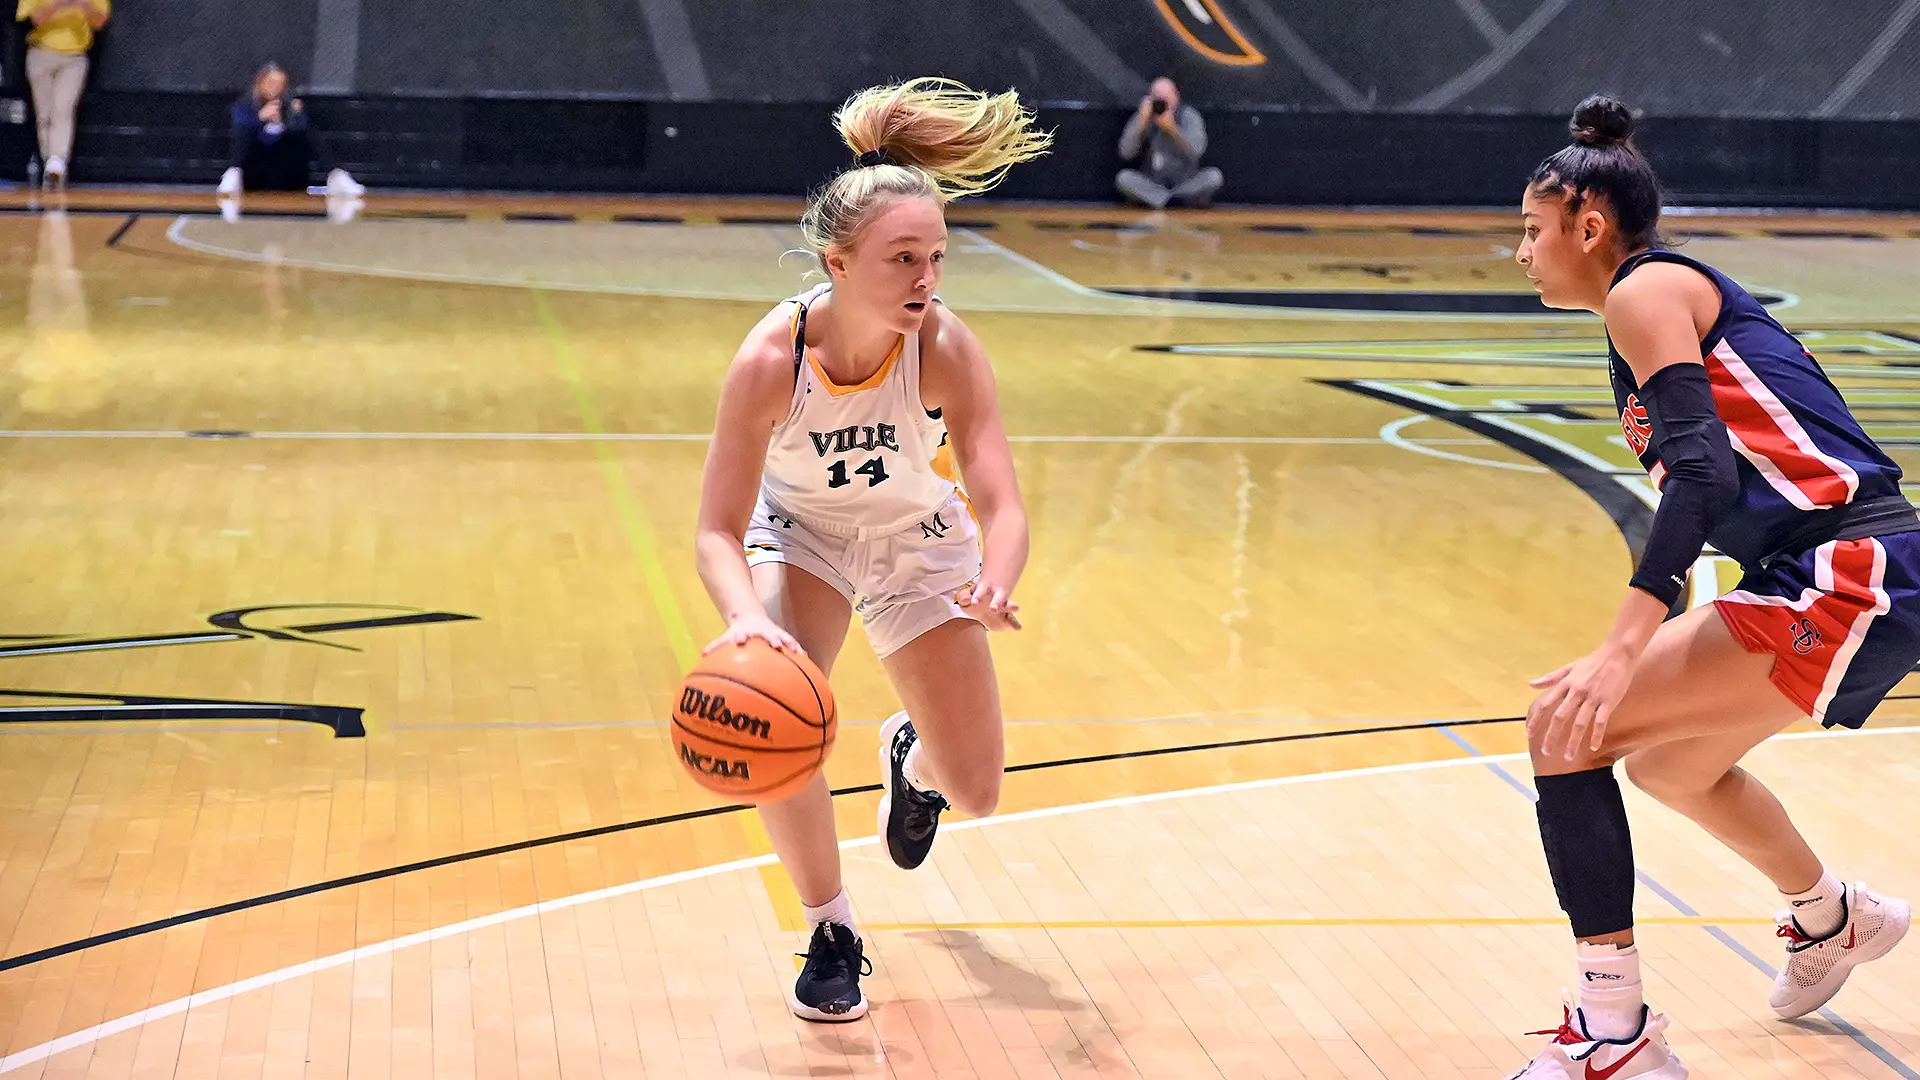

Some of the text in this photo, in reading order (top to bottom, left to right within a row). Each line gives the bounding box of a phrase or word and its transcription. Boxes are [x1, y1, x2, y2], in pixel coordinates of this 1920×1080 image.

[809, 423, 899, 457] VILLE
[827, 454, 890, 488] 14
[680, 686, 771, 739] Wilson
[681, 742, 750, 780] NCAA
